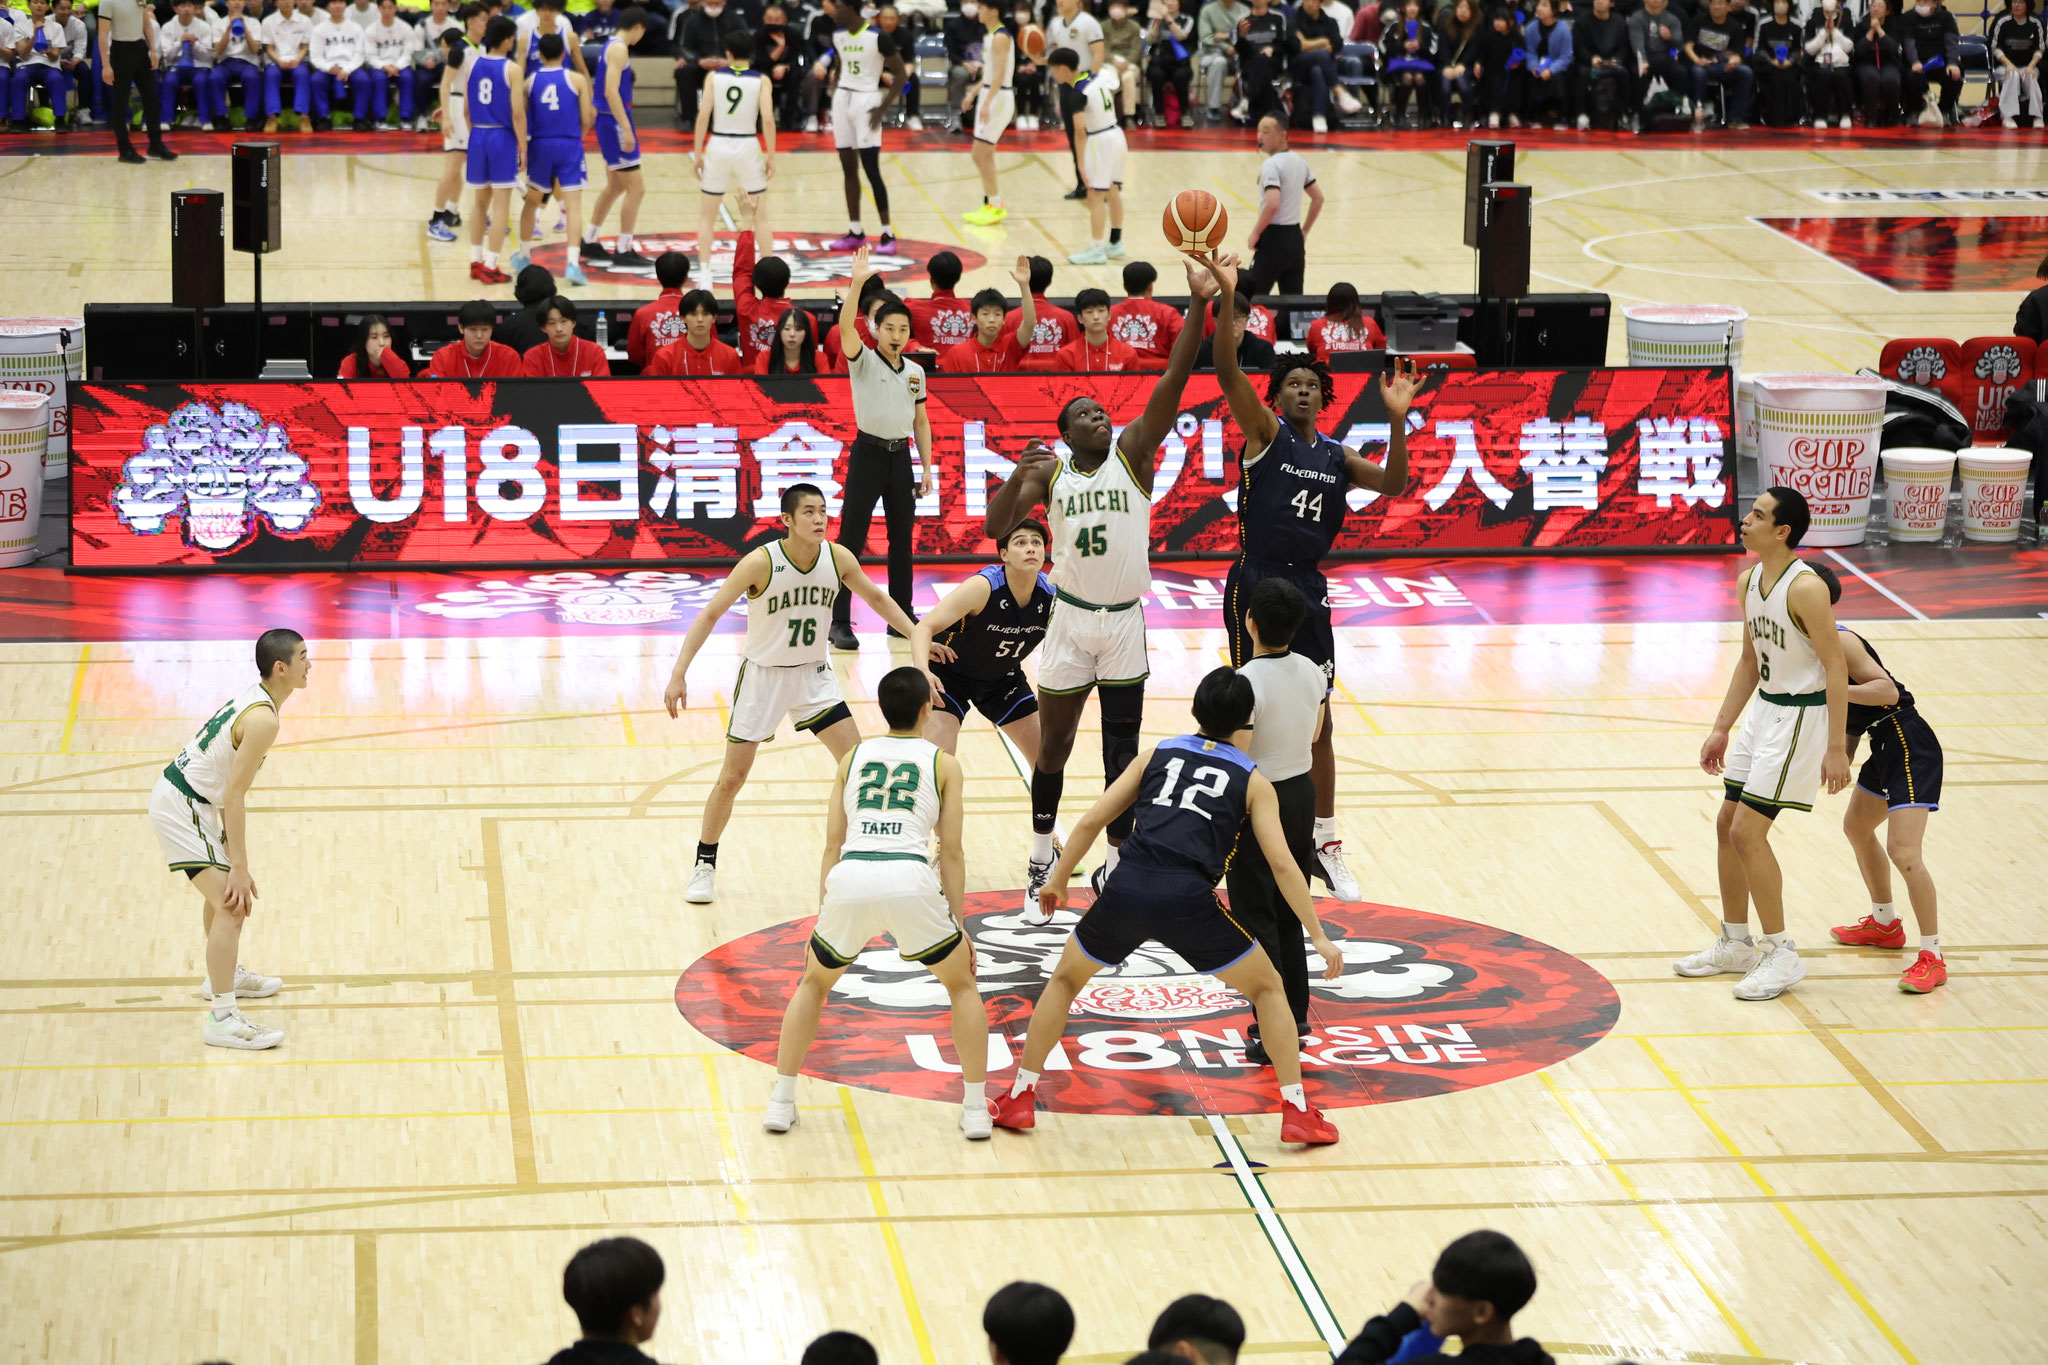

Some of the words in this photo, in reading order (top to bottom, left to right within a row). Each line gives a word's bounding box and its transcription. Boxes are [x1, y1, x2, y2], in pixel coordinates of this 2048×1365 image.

[848, 61, 861, 75] 15
[478, 78, 492, 104] 8
[541, 84, 559, 110] 4
[726, 86, 743, 114] 9
[1789, 437, 1865, 470] CUP
[1290, 489, 1323, 522] 44
[1904, 485, 1945, 503] CUP
[1978, 485, 2019, 503] CUP
[1074, 524, 1107, 557] 45
[767, 586, 835, 615] DAIICHI
[788, 618, 817, 647] 76
[995, 640, 1025, 658] 51
[857, 761, 921, 812] 22
[1152, 757, 1230, 820] 12
[861, 822, 902, 835] TAKU
[904, 1030, 1182, 1073] U18
